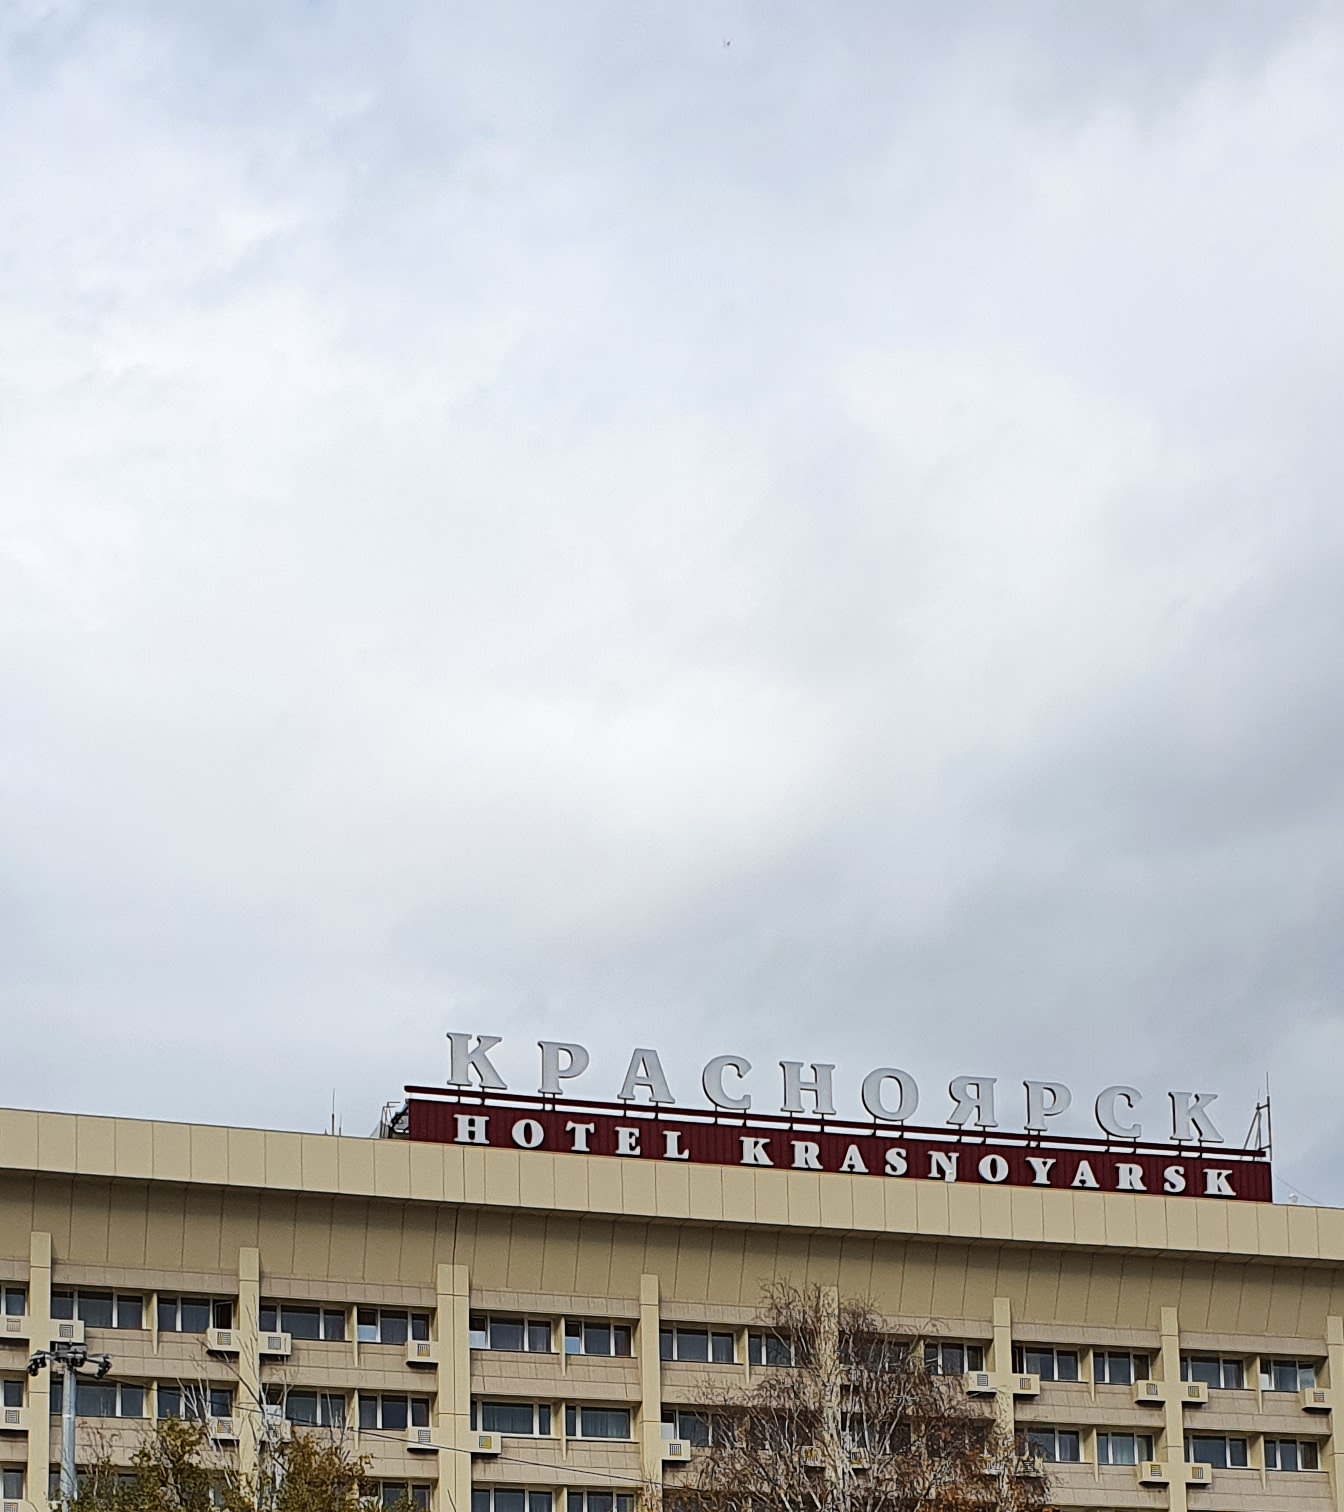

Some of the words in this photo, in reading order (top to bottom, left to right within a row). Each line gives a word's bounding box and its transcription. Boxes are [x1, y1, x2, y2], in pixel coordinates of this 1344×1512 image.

[446, 1032, 1224, 1143] КРАСНОЯРСК
[453, 1114, 690, 1160] HOTEL
[739, 1136, 1236, 1196] KRASNOYARSK
